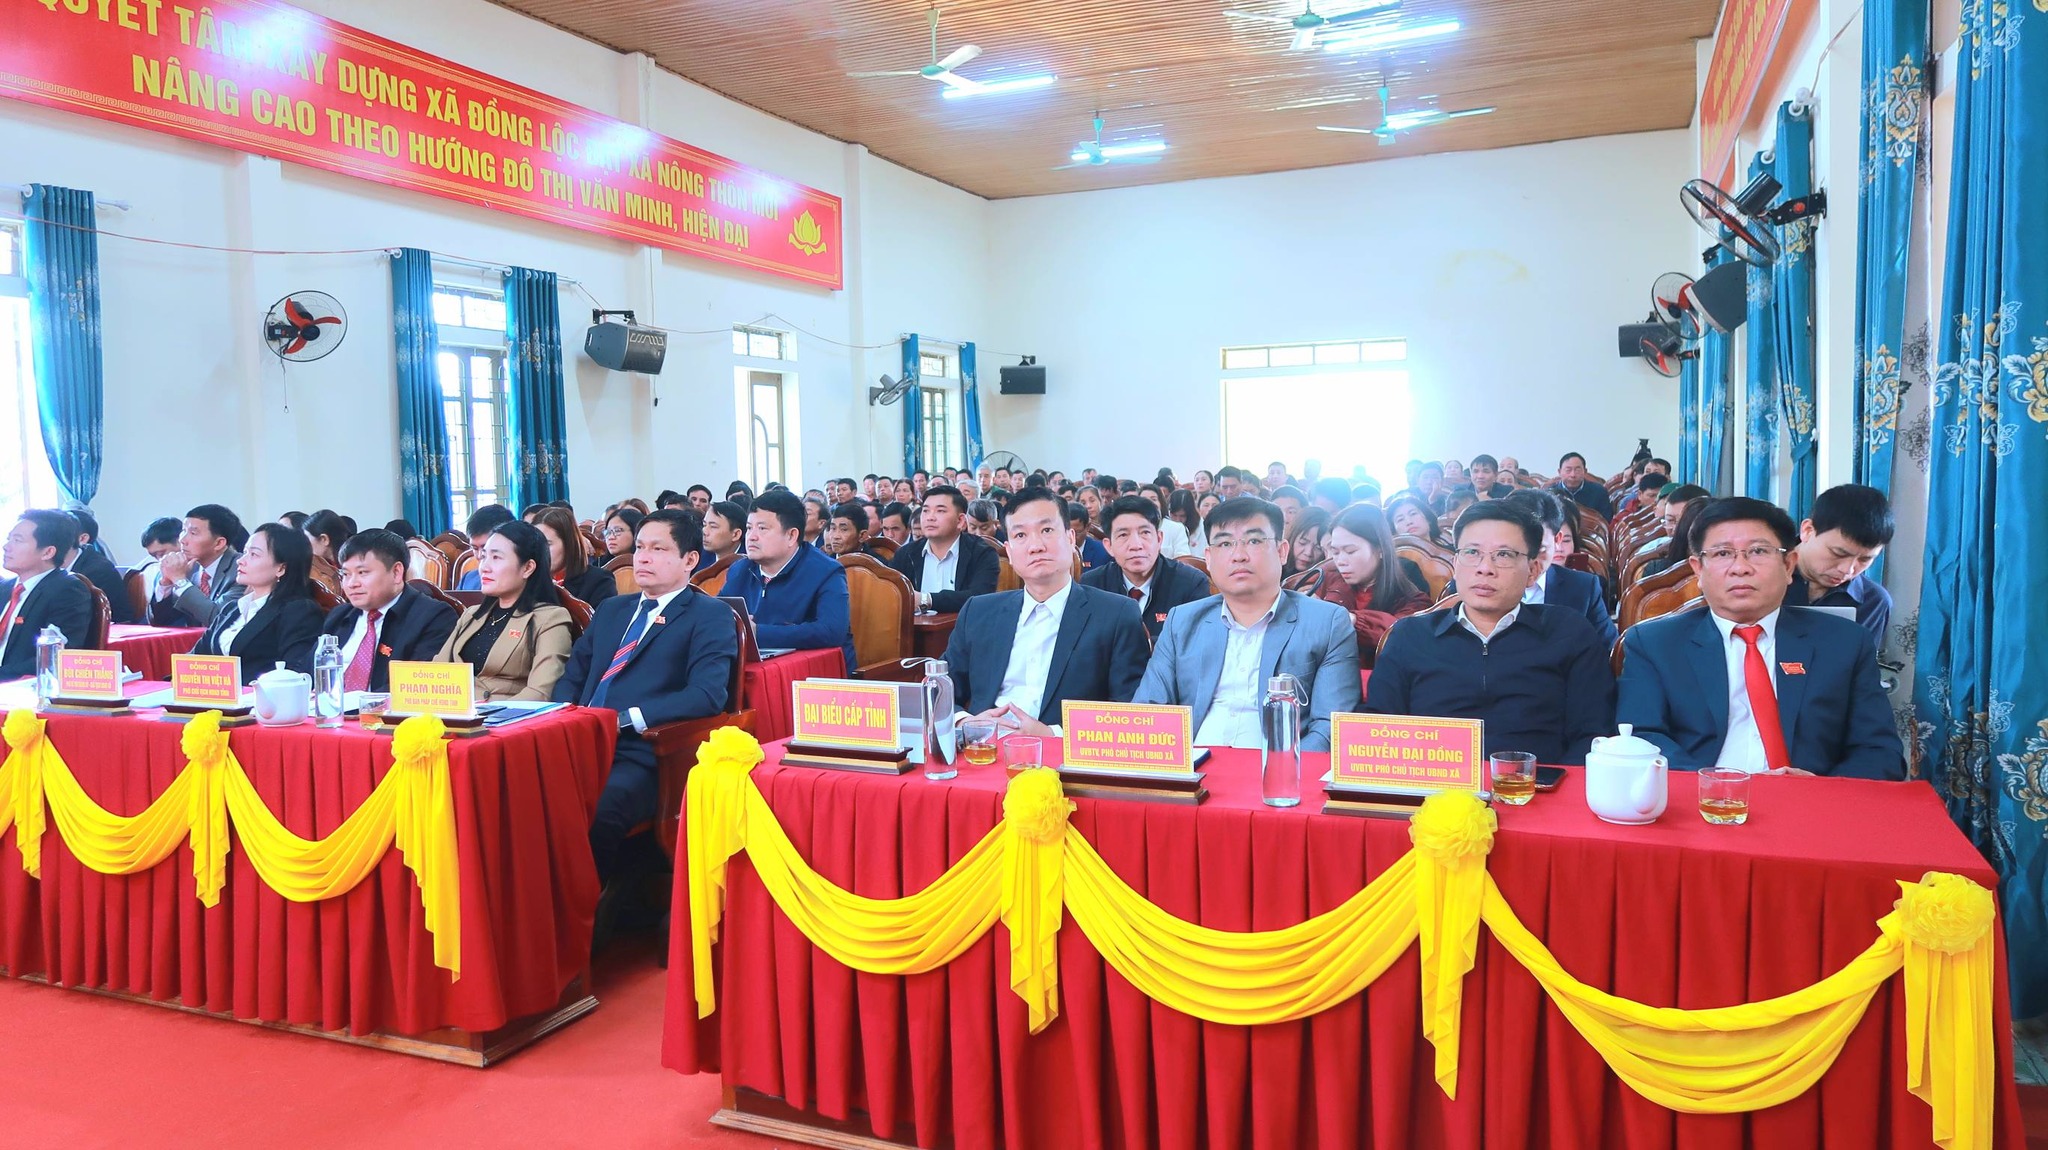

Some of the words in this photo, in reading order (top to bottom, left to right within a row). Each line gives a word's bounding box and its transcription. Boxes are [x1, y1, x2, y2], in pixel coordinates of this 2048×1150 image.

[173, 6, 253, 64] TÂM
[338, 58, 417, 113] DỰNG
[425, 86, 461, 126] XÃ
[468, 97, 533, 147] ĐỒNG
[539, 122, 580, 162] LỘC
[628, 151, 653, 183] XÃ
[657, 160, 705, 198] NÔNG
[708, 177, 748, 212] THÔN
[132, 54, 240, 117] NÂNG
[251, 88, 316, 136] CAO
[326, 107, 400, 158] THEO
[408, 131, 496, 183] HƯỚNG
[503, 157, 534, 192] ĐÔ
[540, 168, 574, 209] THỊ
[579, 178, 620, 214] VĂN
[625, 192, 678, 233] MINH,
[682, 208, 720, 242] HIỆN
[724, 220, 749, 252] ĐẠI
[189, 662, 207, 670] ĐỒNG
[209, 663, 220, 671] CHÍ
[413, 669, 434, 679] ĐỒNG
[400, 683, 428, 696] PHẠM
[432, 683, 462, 695] NGHĨA
[804, 703, 819, 728] ĐẠI
[821, 697, 842, 726] BIỂU
[844, 700, 863, 727] CẤP
[865, 700, 887, 729] TỈNH
[1095, 712, 1130, 725] ĐỒNG
[1133, 716, 1154, 725] CHÍ
[1077, 730, 1113, 743] PHAN
[1117, 732, 1145, 744] ANH
[1149, 732, 1176, 746] ĐỨC
[1370, 725, 1410, 739] ĐỒNG
[1414, 729, 1439, 740] CHÍ
[1101, 747, 1114, 757] PHÓ
[1115, 747, 1128, 758] CHỦ
[1129, 750, 1144, 760] TỊCH
[1146, 751, 1163, 760] UBND
[1164, 750, 1175, 760] XÃ
[1348, 742, 1399, 759] NGUYỄN
[1402, 747, 1424, 762] ĐẠI
[1427, 745, 1463, 763] ĐỒNG
[1375, 763, 1390, 774] PHÓ
[1392, 763, 1406, 775] CHỦ
[1409, 766, 1425, 777] TỊCH
[1427, 767, 1448, 777] UBND
[1449, 767, 1460, 778] XÃ
